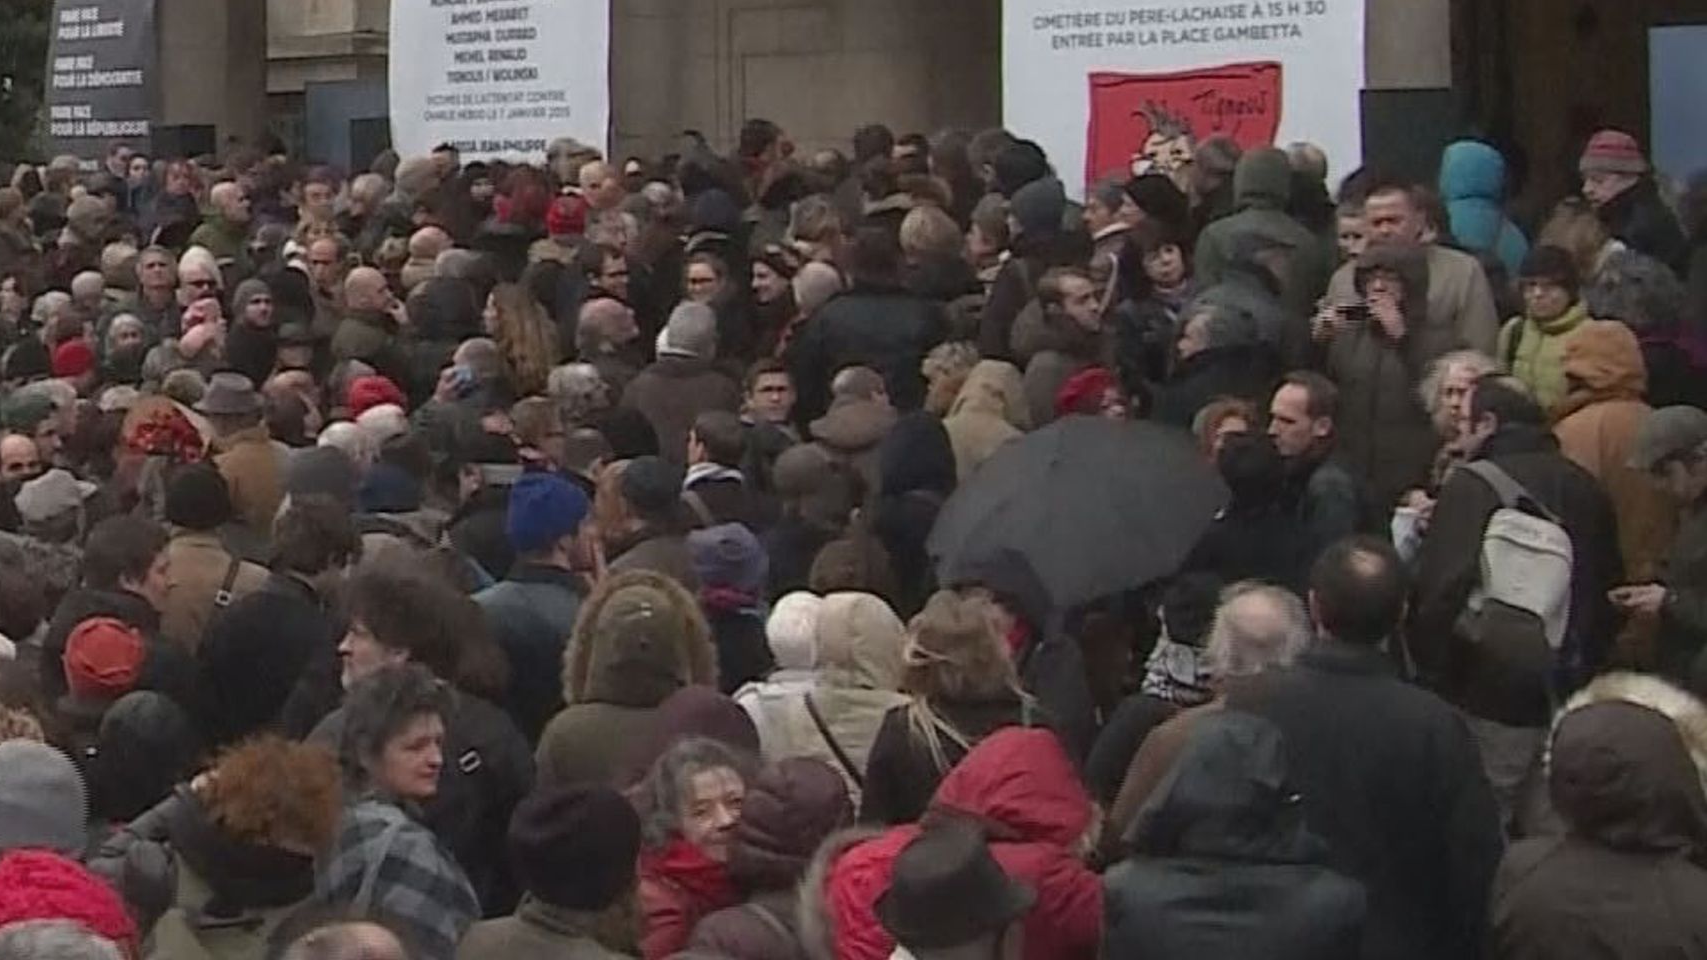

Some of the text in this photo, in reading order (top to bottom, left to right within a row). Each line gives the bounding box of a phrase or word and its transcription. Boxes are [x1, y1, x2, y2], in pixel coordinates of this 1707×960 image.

[1105, 9, 1126, 25] DU
[1251, 0, 1264, 19] À
[1267, 2, 1284, 19] 15
[1288, 2, 1300, 16] H
[1303, 0, 1327, 15] 30
[1106, 30, 1135, 46] PAR
[1138, 28, 1159, 44] LA
[1162, 28, 1210, 44] PLACE
[1214, 23, 1301, 41] GAMBETTA
